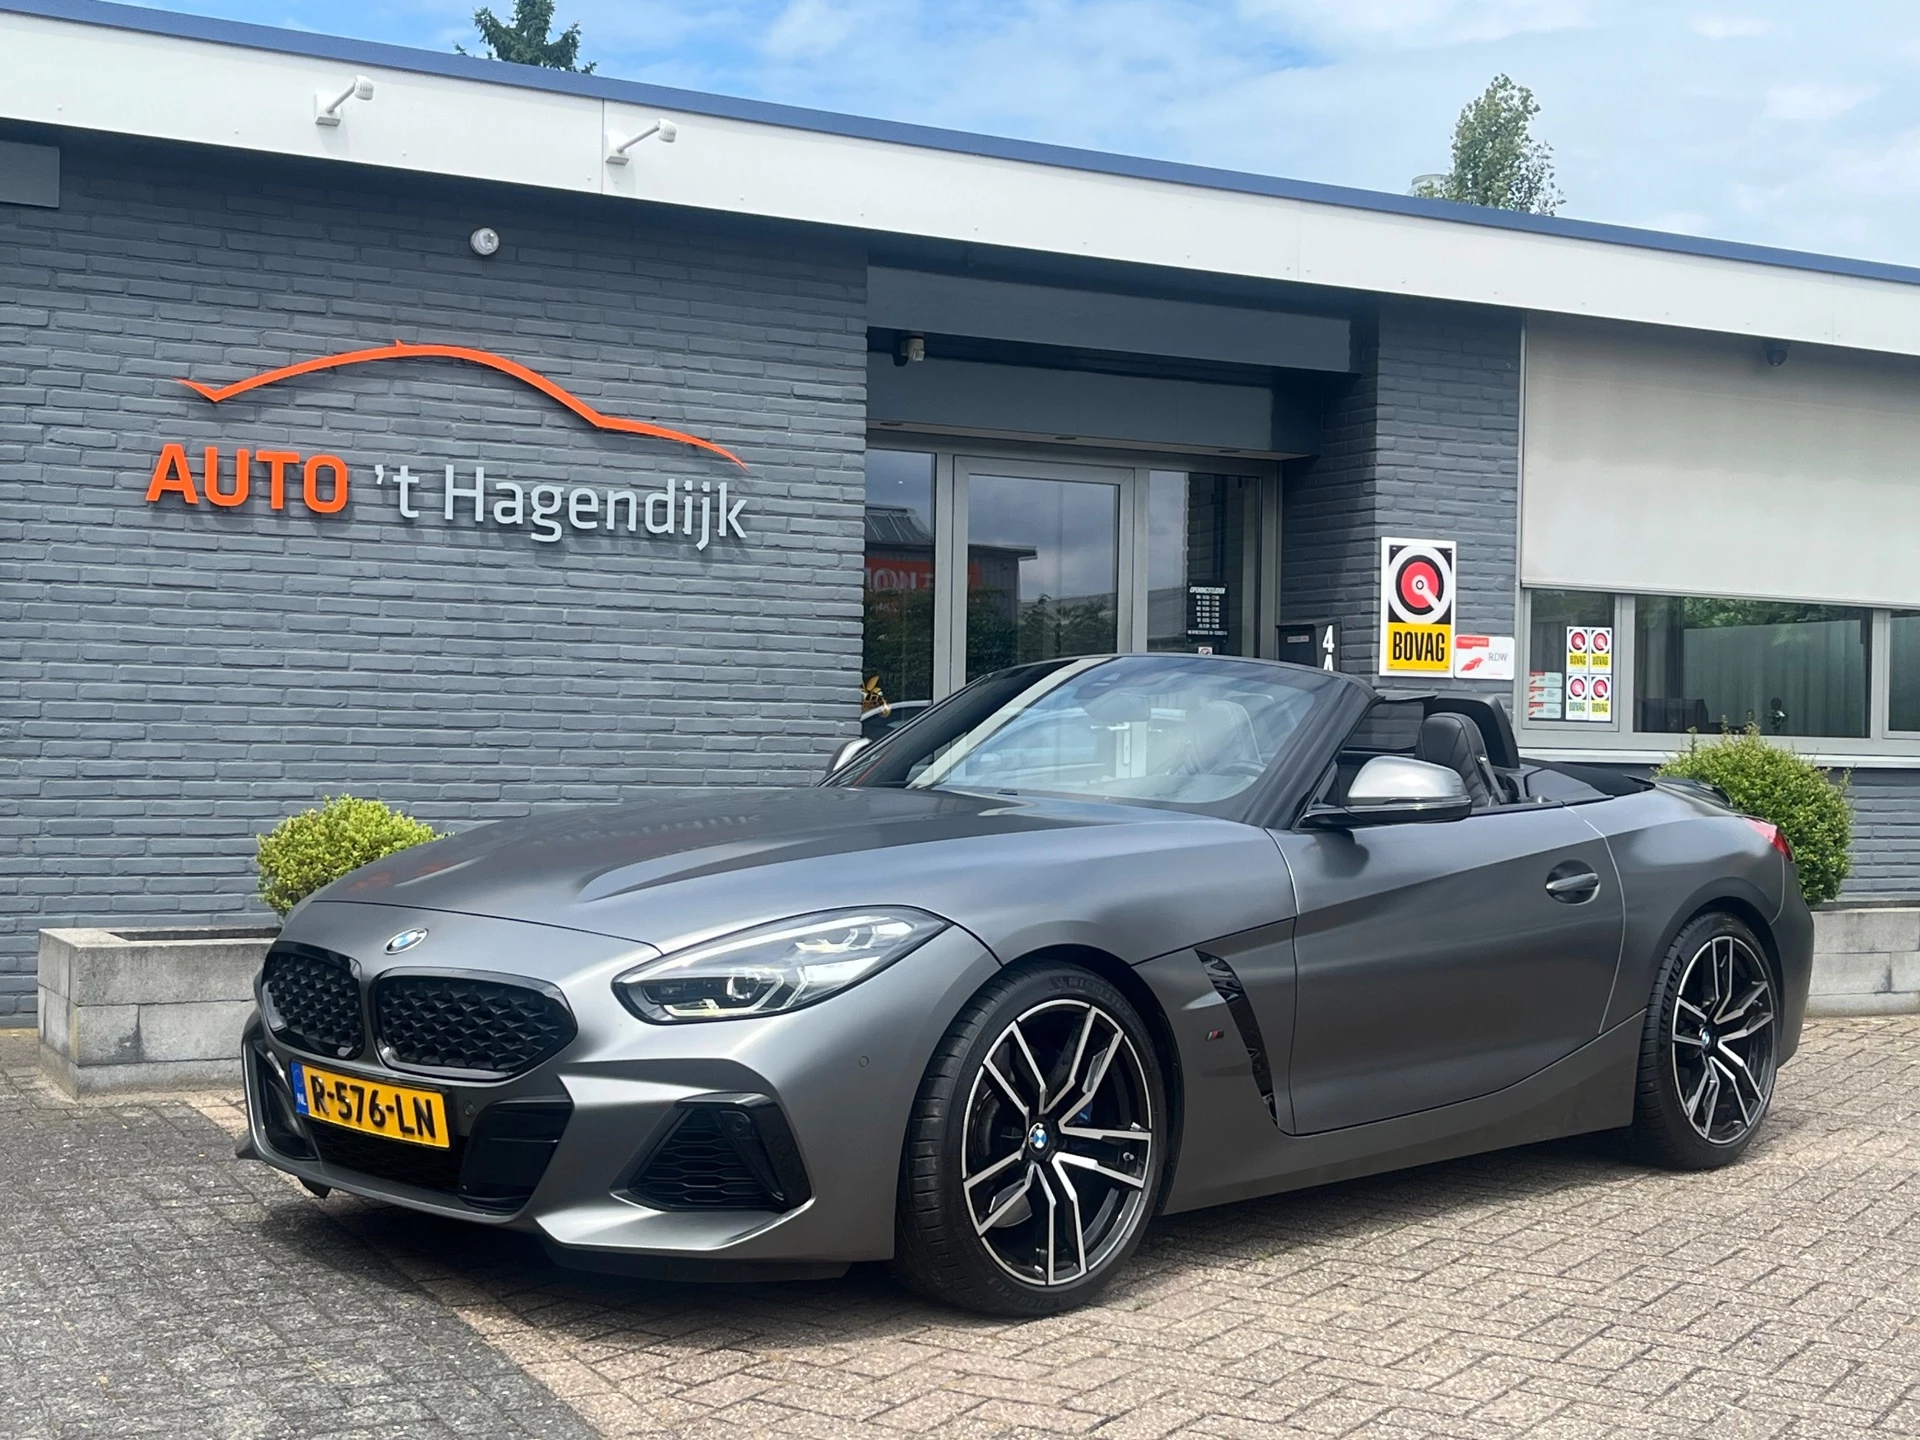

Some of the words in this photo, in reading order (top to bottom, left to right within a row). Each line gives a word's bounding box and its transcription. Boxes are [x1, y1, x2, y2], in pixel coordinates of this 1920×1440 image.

[145, 443, 349, 514] AUTO
[374, 462, 420, 518] 't
[444, 464, 749, 550] Hagendijk
[1322, 624, 1335, 653] 4
[1392, 630, 1446, 662] BOVAG
[1488, 652, 1508, 662] RDW
[297, 1092, 308, 1106] NL
[310, 1074, 436, 1139] R-576-LN
